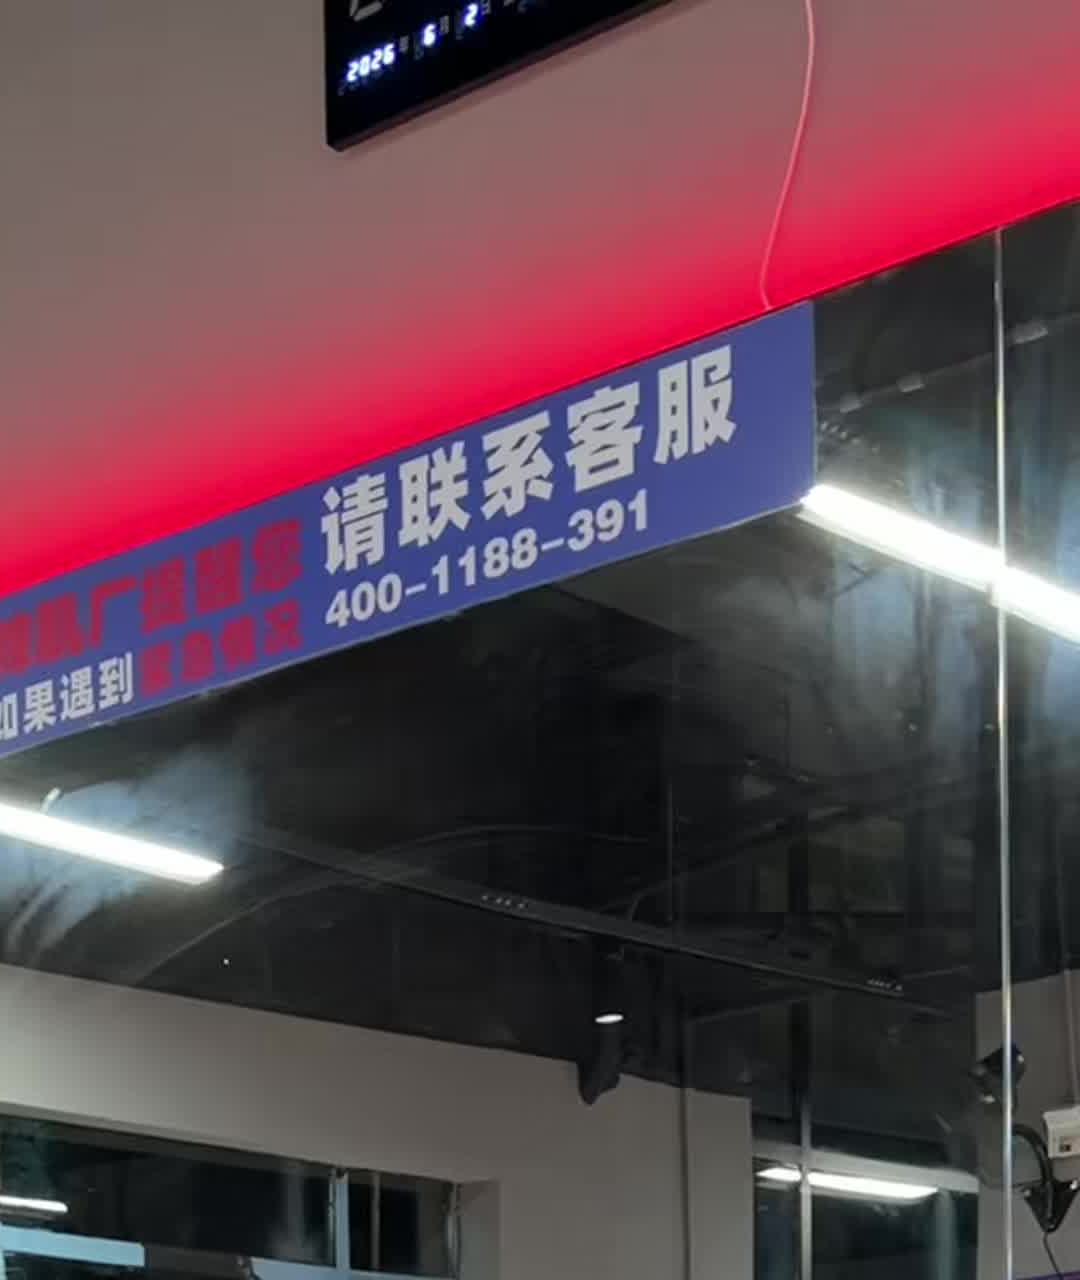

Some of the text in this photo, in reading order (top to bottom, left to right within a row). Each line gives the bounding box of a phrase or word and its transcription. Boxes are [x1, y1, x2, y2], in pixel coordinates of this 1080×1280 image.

[321, 345, 737, 575] 请联系客服
[325, 488, 648, 629] 400-1188-391
